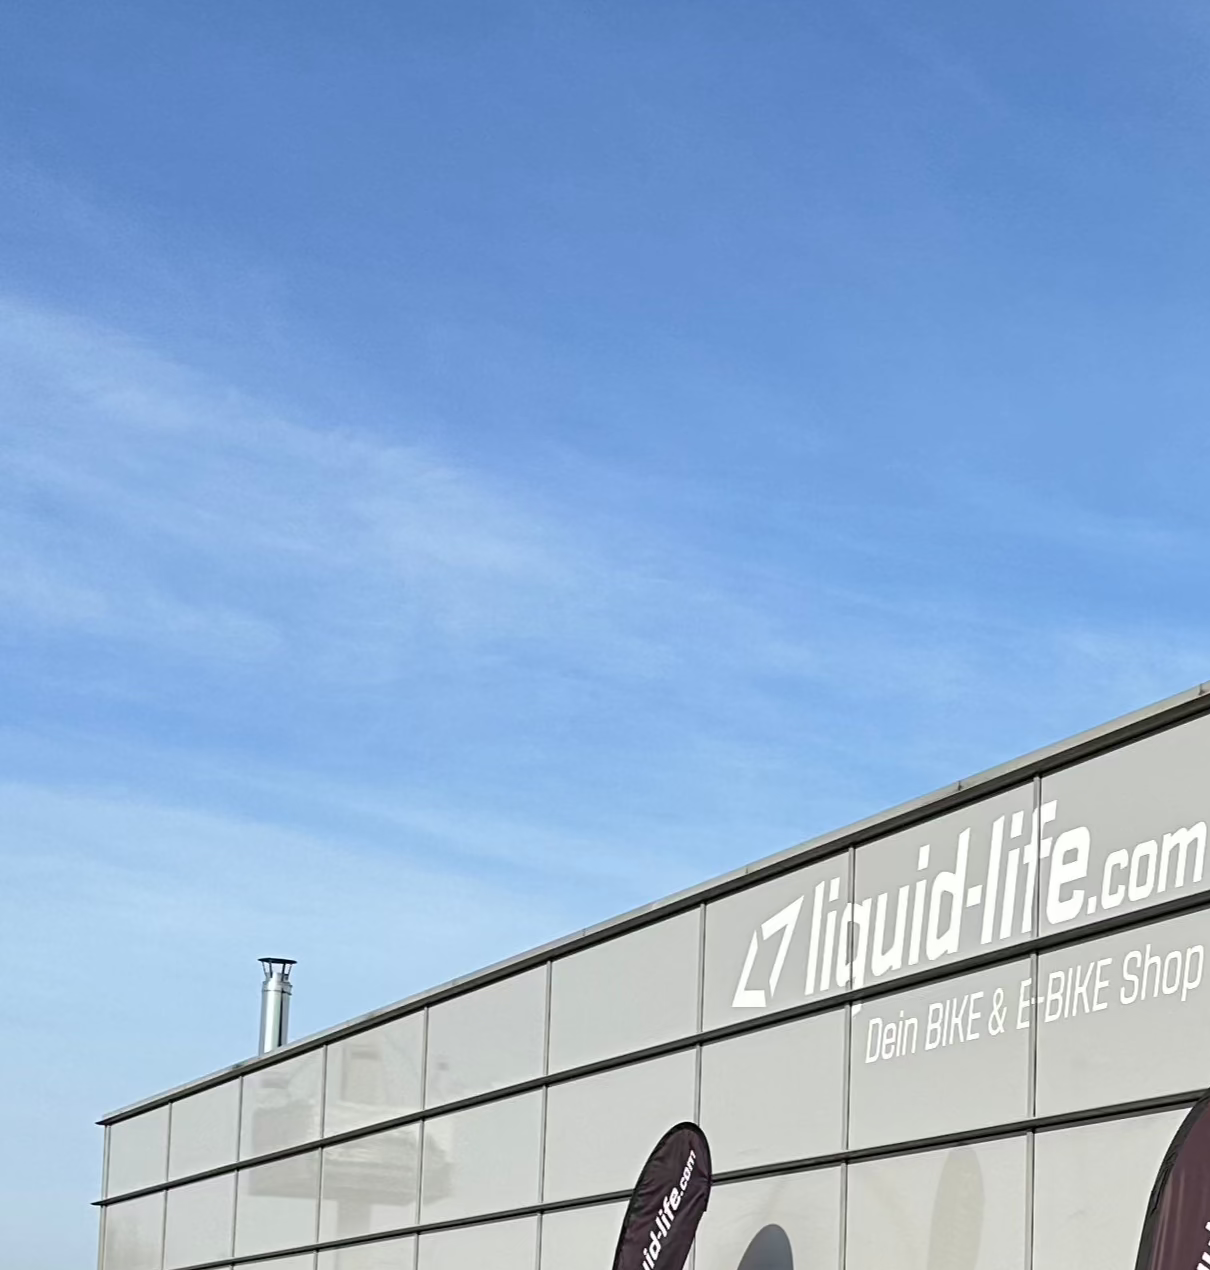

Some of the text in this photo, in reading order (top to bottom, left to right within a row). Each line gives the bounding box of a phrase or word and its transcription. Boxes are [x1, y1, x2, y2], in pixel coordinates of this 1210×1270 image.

[804, 799, 1208, 1016] liquid-life.com
[865, 943, 1205, 1064] Dein BIKE & E-BIKE Shop
